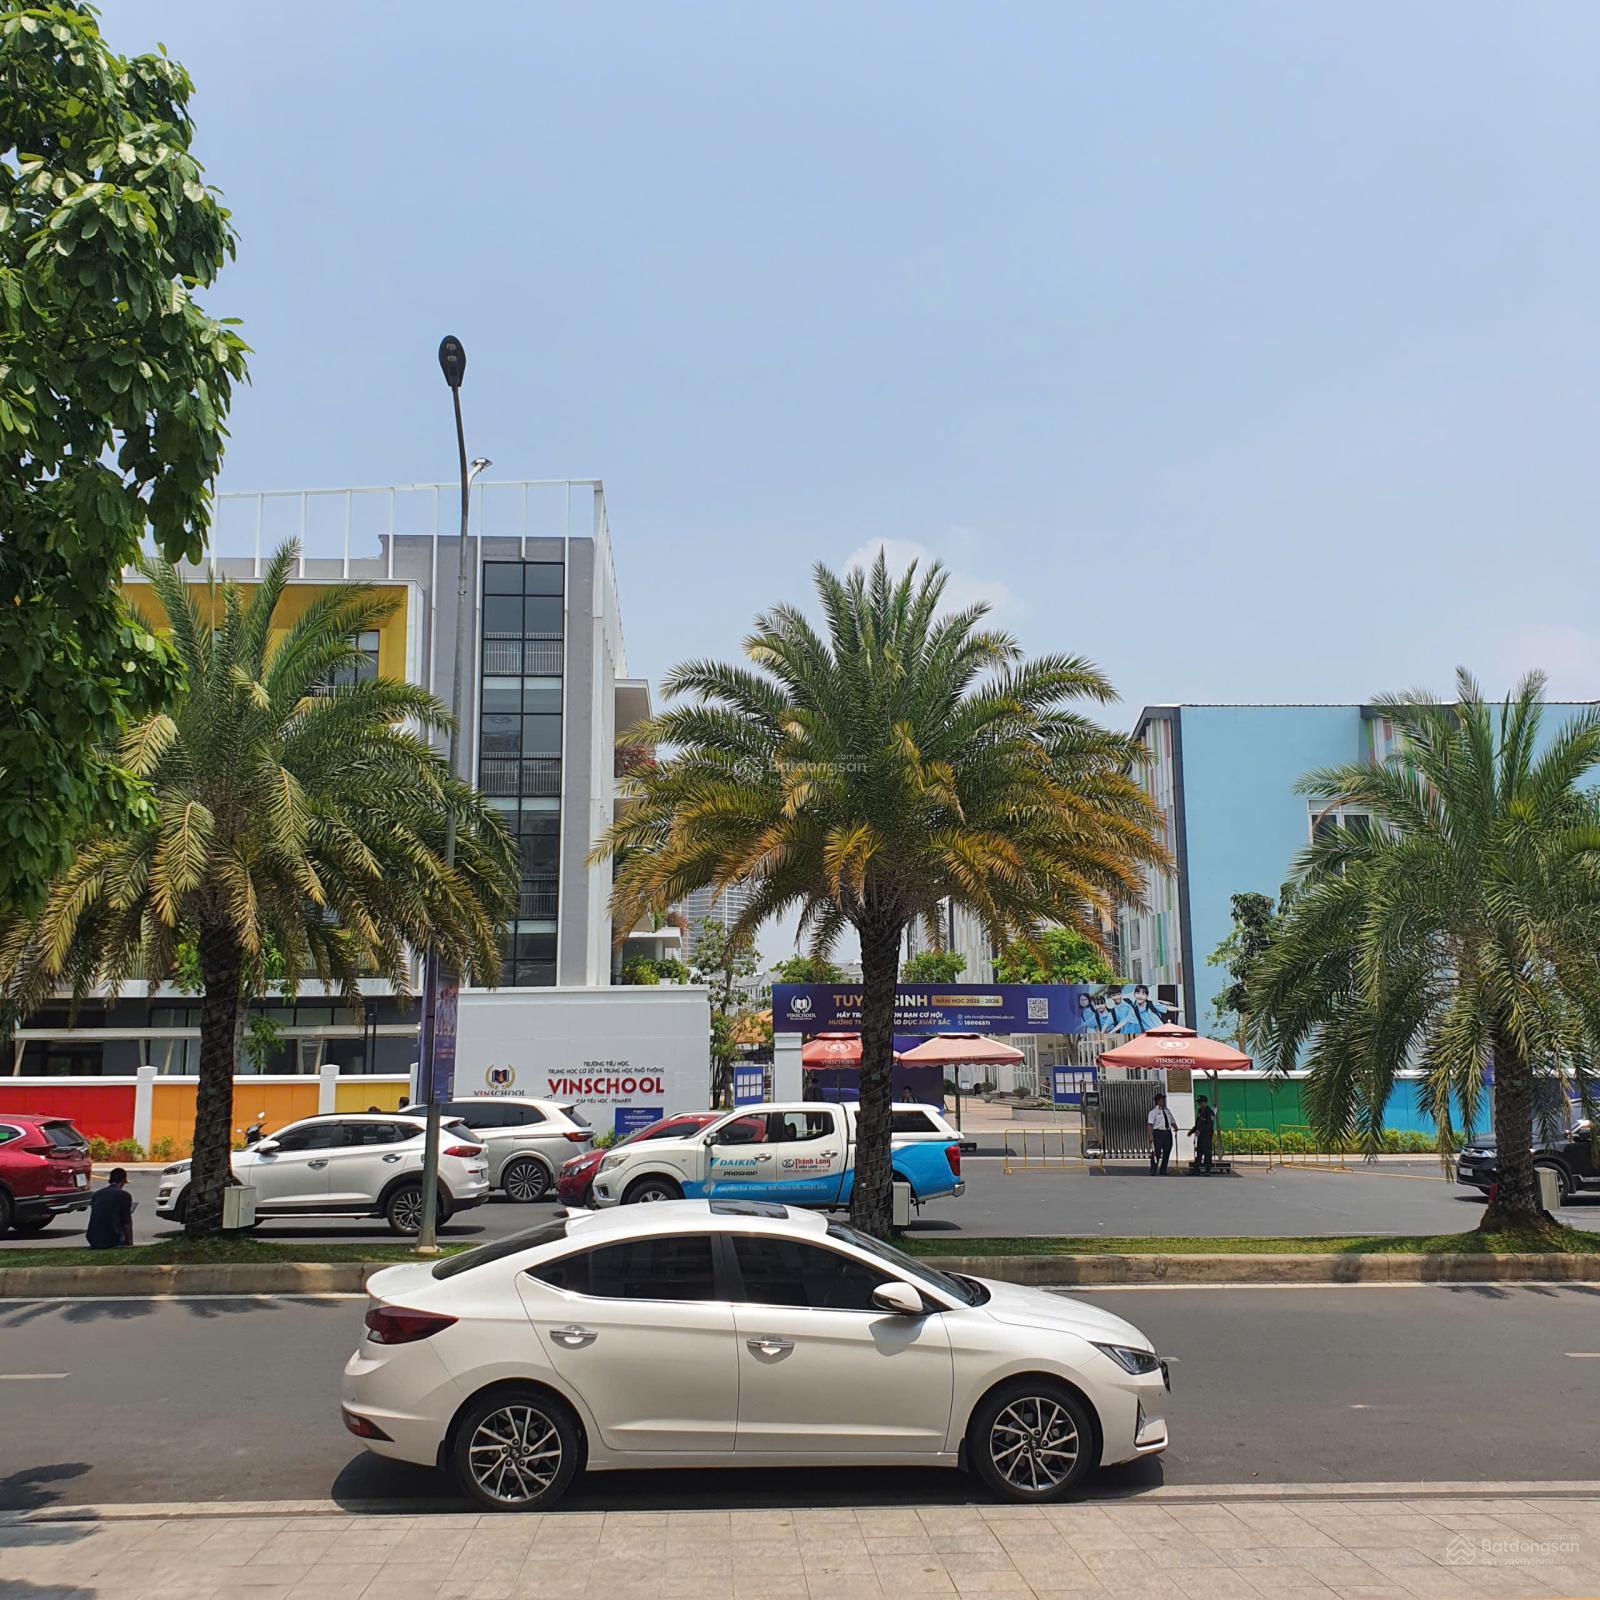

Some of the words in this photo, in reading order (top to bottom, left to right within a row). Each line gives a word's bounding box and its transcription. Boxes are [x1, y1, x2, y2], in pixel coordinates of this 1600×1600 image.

[832, 994, 864, 1007] TUY
[548, 1077, 664, 1095] VINSCHOOL
[720, 1159, 757, 1167] DAIKIN
